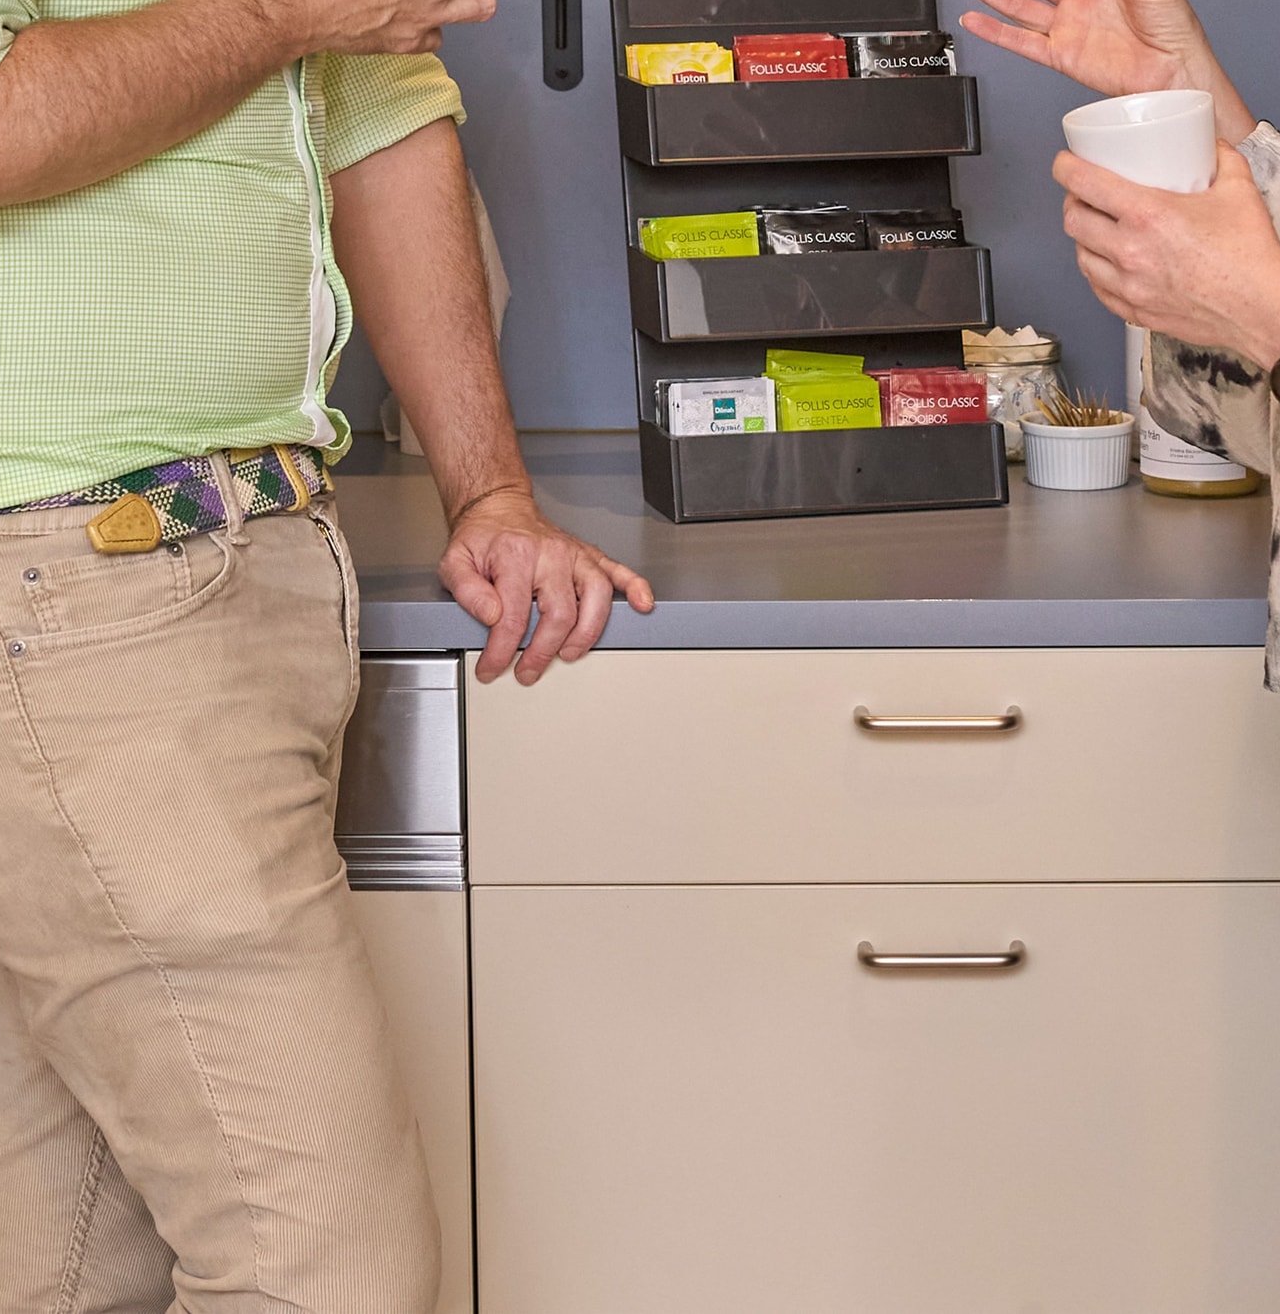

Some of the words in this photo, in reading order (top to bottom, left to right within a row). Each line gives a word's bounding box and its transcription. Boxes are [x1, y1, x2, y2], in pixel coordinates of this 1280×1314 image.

[750, 63, 784, 75] FOLLIS
[786, 62, 827, 74] CLASSIC
[874, 57, 907, 69] FOLLIS
[909, 55, 950, 67] CLASSIC
[675, 73, 706, 83] Lipton
[672, 231, 706, 243] FOLLIS
[709, 228, 752, 241] CLASSIC
[815, 232, 856, 243] CLASSIC
[880, 232, 914, 244] FOLLIS
[915, 230, 957, 241] CLASSIC
[674, 247, 706, 257] GREEN
[707, 246, 726, 256] TEA
[796, 399, 830, 412] FOLLIS
[832, 397, 874, 409] CLASSIC
[900, 398, 935, 409] FOLLIS
[936, 396, 979, 408] CLASSIC
[797, 416, 830, 427] GREEN
[832, 415, 849, 425] TEA
[901, 413, 948, 424] ROOIBOS
